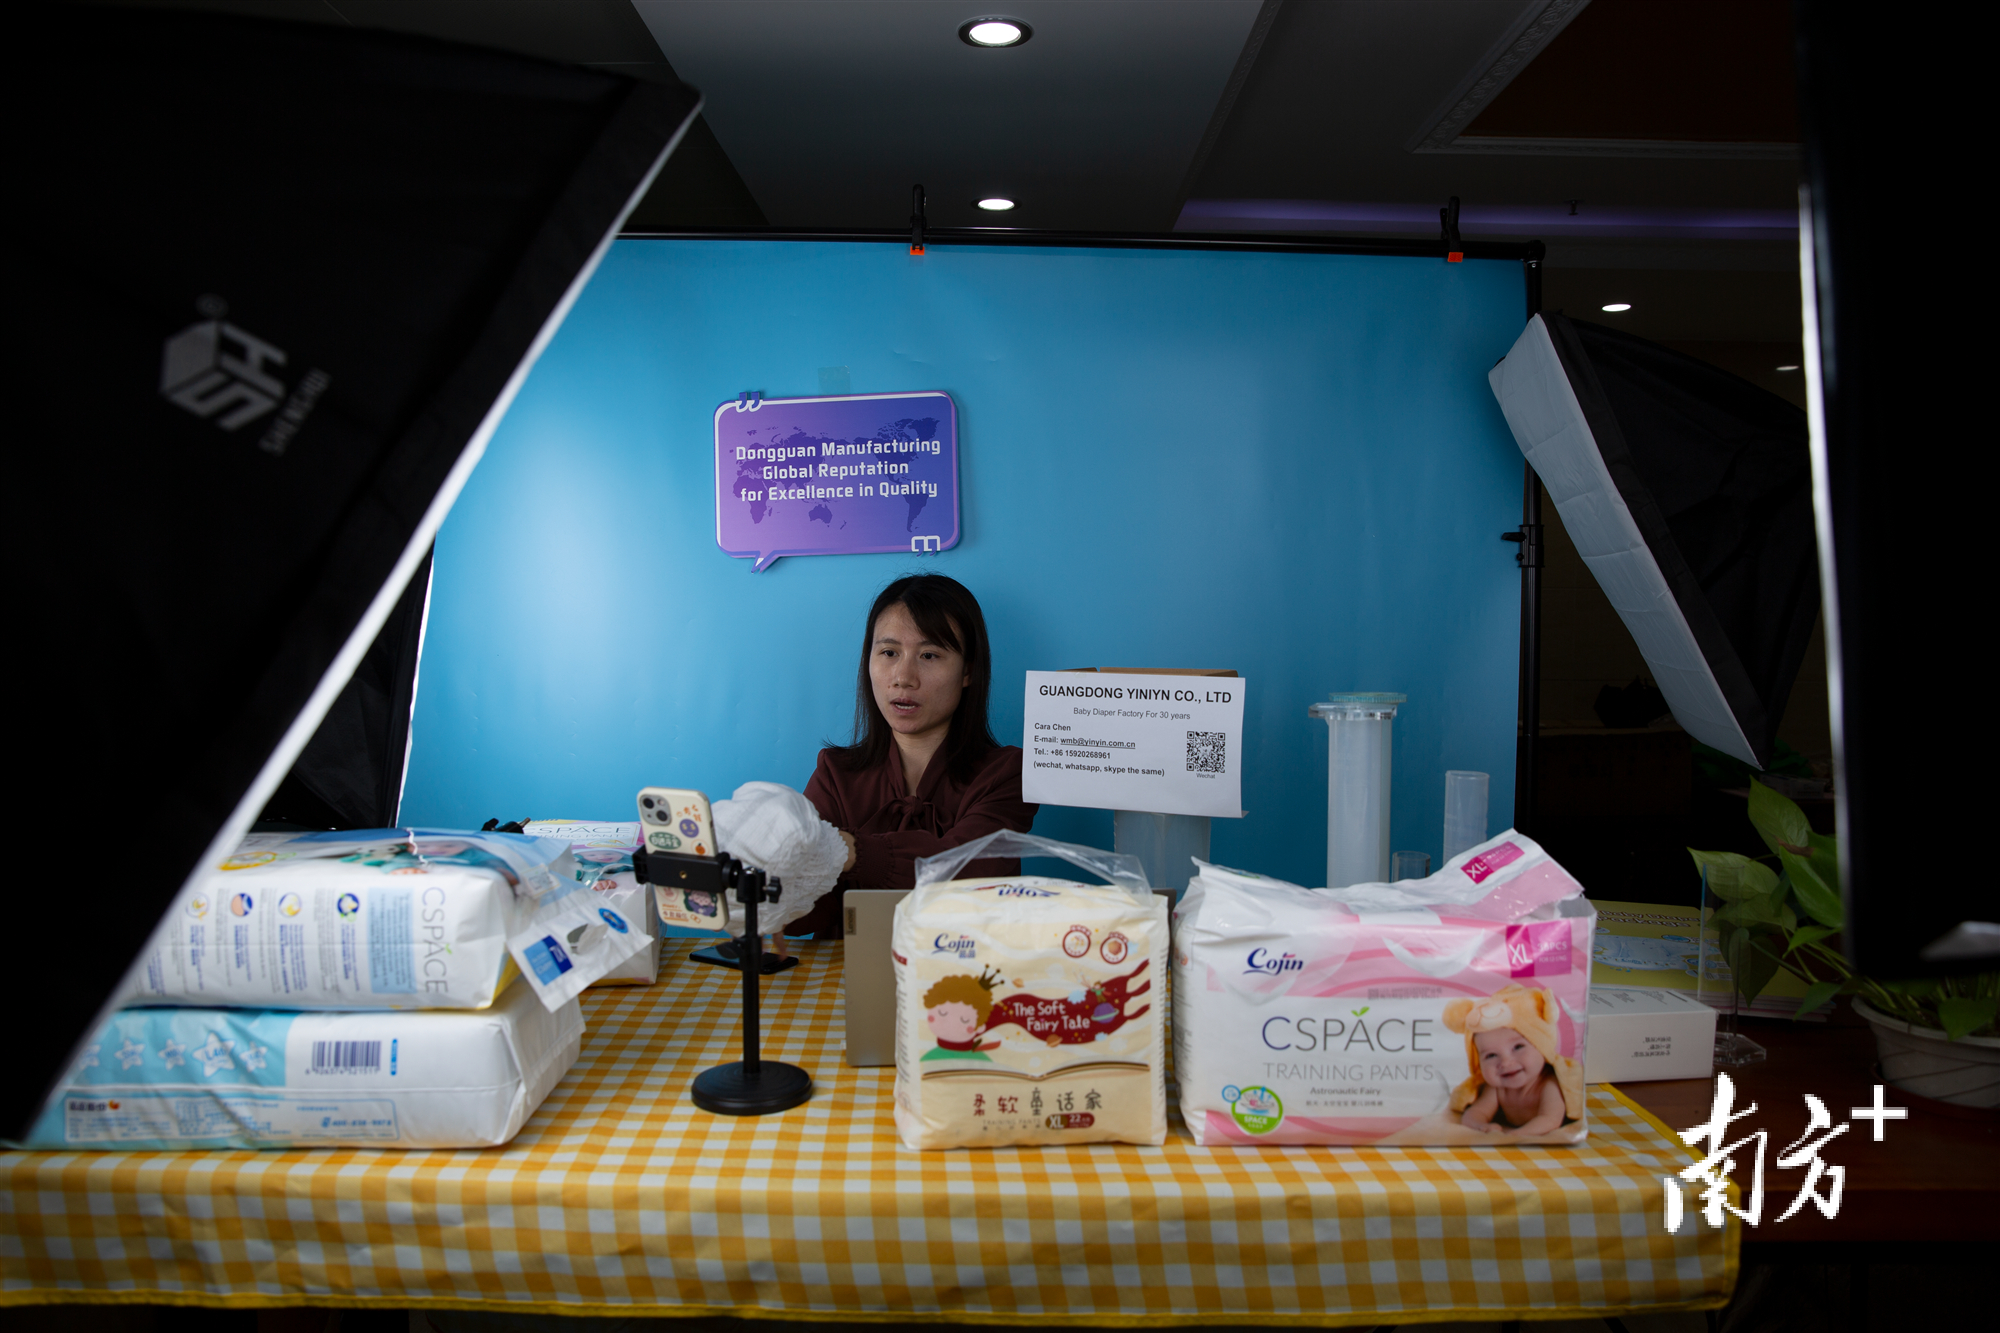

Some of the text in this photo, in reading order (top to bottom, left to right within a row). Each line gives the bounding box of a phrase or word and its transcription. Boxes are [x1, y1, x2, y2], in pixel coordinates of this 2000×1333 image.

[735, 439, 941, 462] Dongguan Manufacturing
[763, 460, 909, 480] Global Reputation
[740, 480, 938, 502] for Excellence in Quality
[1039, 684, 1232, 704] GUANGDONG YINIYN CO., LTD
[1073, 707, 1191, 721] Baby Diaper Factory For 30 years
[1034, 722, 1071, 731] Cara Chen
[1034, 735, 1136, 749] E-mail: wmb@yinyin.com.cn
[1033, 748, 1111, 760] Tel.: +86 15920268961
[1033, 760, 1165, 778] (wechat, whatsapp, skype the same)
[1466, 863, 1488, 879] XL
[421, 886, 449, 994] CSPACE
[933, 932, 976, 954] Cojin
[1246, 947, 1304, 976] Cojin
[1509, 943, 1534, 964] XL
[1013, 1000, 1066, 1017] The Soft
[1026, 1014, 1090, 1033] Fairy Tale
[1262, 1015, 1434, 1053] CSPACE
[1263, 1063, 1434, 1081] TRAINING PANTS
[1310, 1086, 1381, 1097] Astronautic Fairy
[973, 1087, 1102, 1117] 柔软童话家
[1049, 1115, 1064, 1128] XL
[1069, 1114, 1081, 1123] 22
[1244, 1115, 1268, 1125] SPACE
